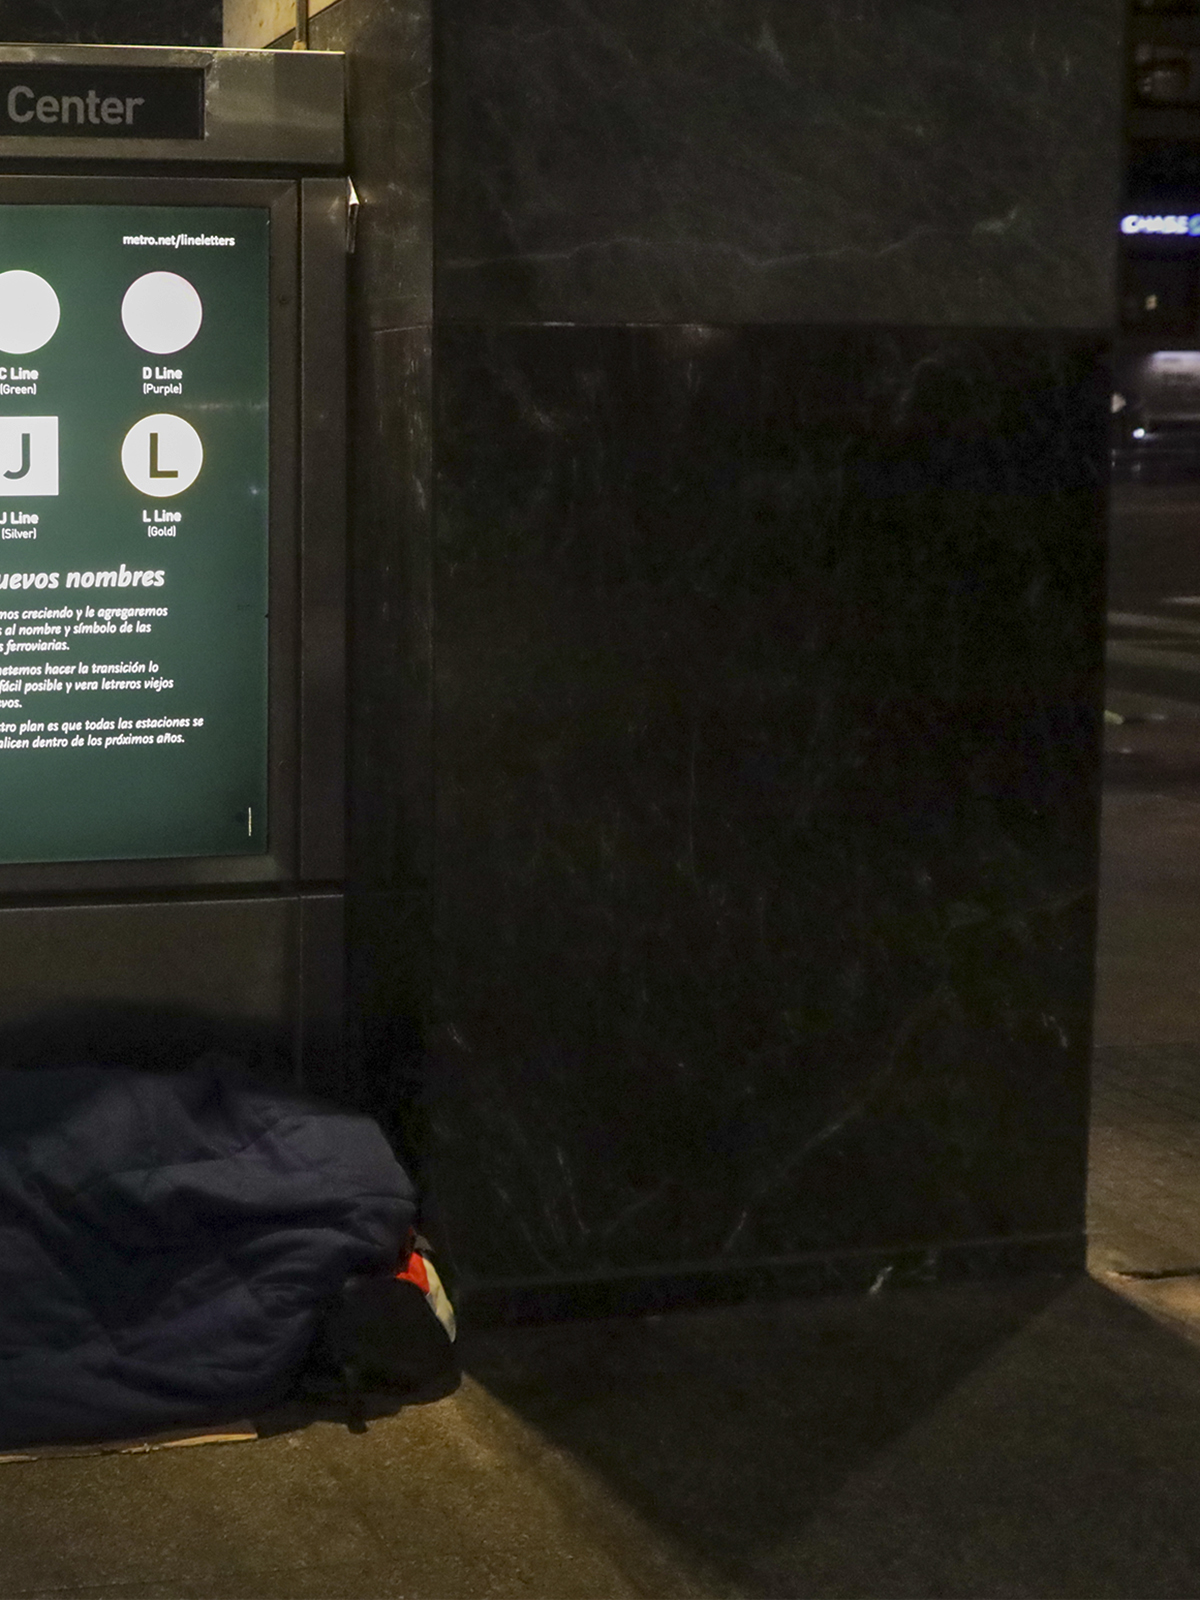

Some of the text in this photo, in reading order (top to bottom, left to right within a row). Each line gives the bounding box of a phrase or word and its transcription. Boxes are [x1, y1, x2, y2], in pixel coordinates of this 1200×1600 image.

[7, 85, 146, 125] Center
[1120, 214, 1189, 234] CHASE
[122, 233, 236, 249] metro.net/lineletters
[10, 367, 39, 380] Line
[142, 367, 183, 379] D Line
[0, 383, 37, 395] (Green)
[143, 383, 182, 396] (Purple)
[3, 433, 31, 480] J
[149, 432, 179, 478] L
[0, 511, 39, 525] J Line
[143, 509, 182, 522] L Line
[2, 527, 37, 540] (Silver)
[148, 525, 176, 537] (Gold)
[66, 564, 165, 588] nombres
[22, 606, 73, 619] creciendo
[76, 609, 83, 621] y
[85, 605, 95, 618] le
[97, 607, 168, 621] agregaremos
[4, 623, 16, 636] al
[18, 622, 61, 635] nombre
[64, 626, 71, 637] y
[73, 621, 117, 634] símbolo
[119, 621, 133, 633] de
[136, 620, 151, 633] las
[3, 639, 70, 655] ferroviarias.
[44, 662, 76, 675] hacer
[78, 662, 89, 674] la
[91, 661, 146, 674] transición
[148, 660, 159, 673] lo
[24, 678, 63, 695] posible
[65, 682, 72, 694] y
[101, 677, 141, 690] letreros
[144, 677, 174, 692] viejos
[19, 719, 44, 735] plan
[47, 722, 59, 731] es
[61, 722, 82, 734] que
[85, 718, 115, 730] todas
[117, 717, 133, 729] las
[135, 716, 190, 729] estaciones
[192, 718, 204, 727] se
[32, 735, 68, 748] dentro
[71, 734, 85, 747] de
[87, 734, 102, 746] los
[104, 733, 154, 749] próximos
[156, 733, 185, 744] años.
